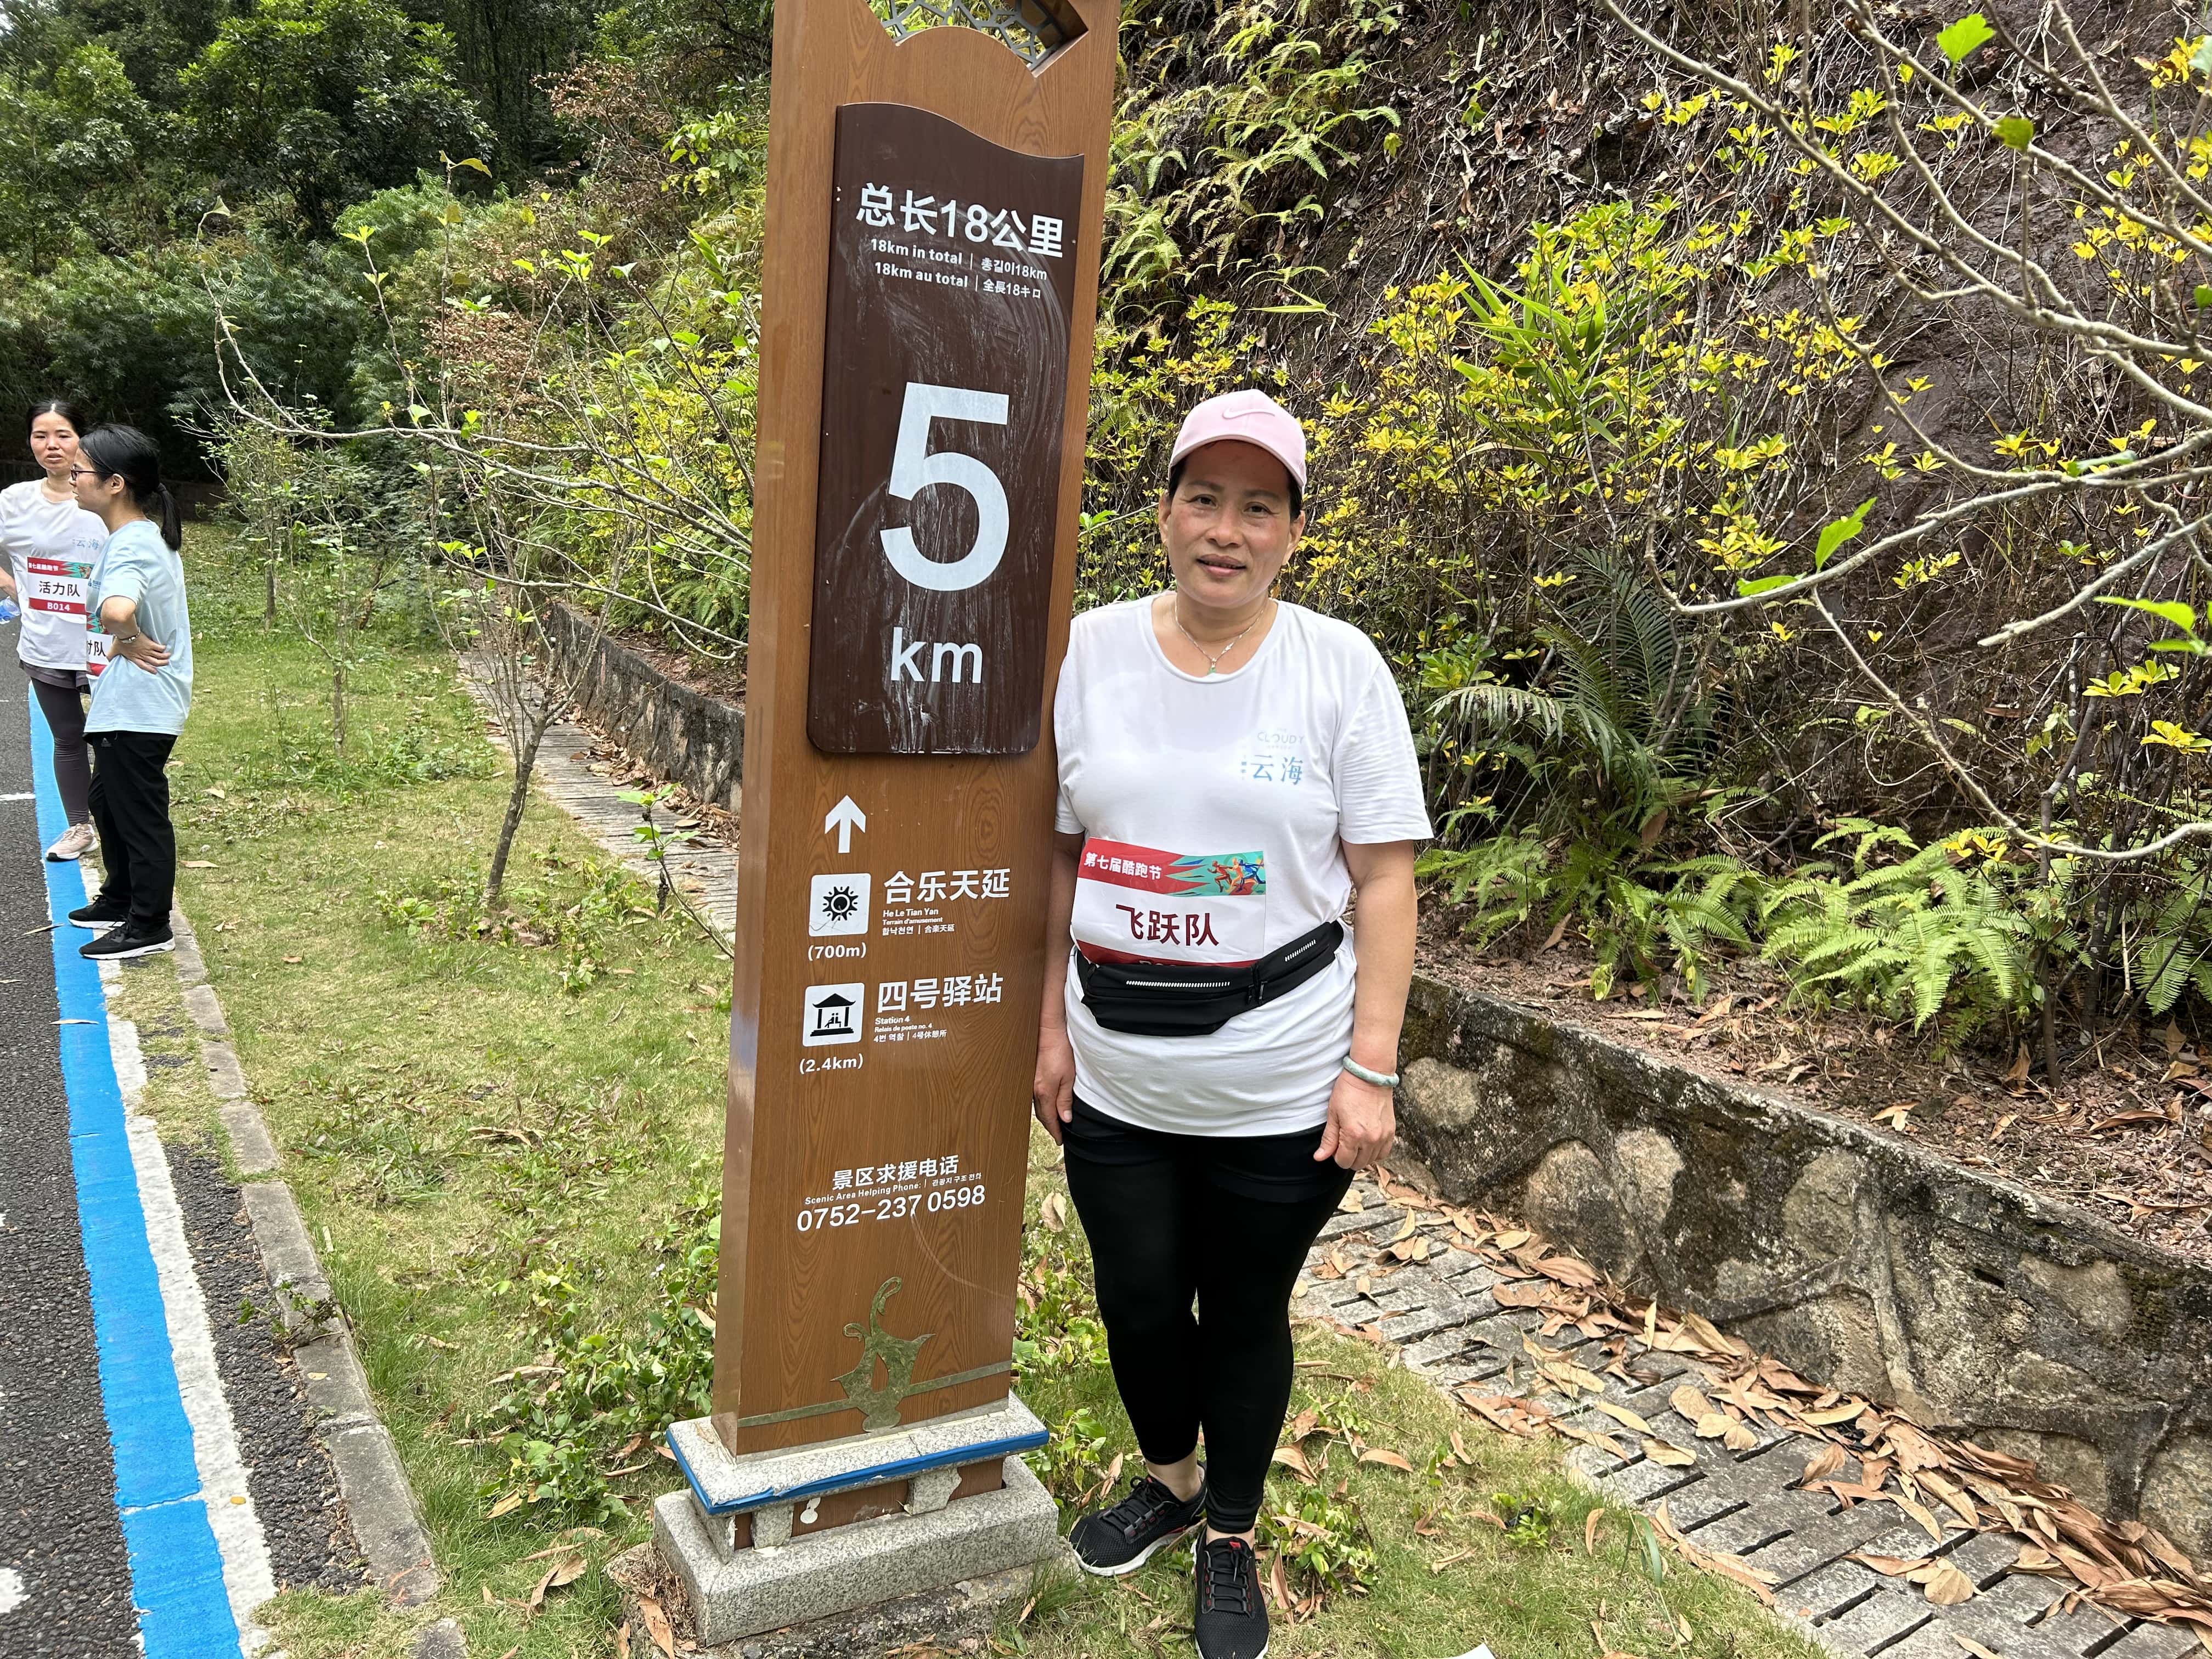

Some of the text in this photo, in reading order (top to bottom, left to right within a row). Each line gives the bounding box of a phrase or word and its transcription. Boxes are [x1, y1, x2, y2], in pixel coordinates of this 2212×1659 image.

[856, 182, 1063, 258] 总长18公里
[871, 238, 962, 266] 18km in total
[875, 262, 968, 288] 18km au total
[879, 381, 1009, 592] 5
[39, 580, 81, 597] 活力队
[47, 602, 70, 612] B014
[890, 627, 984, 684] km
[1250, 754, 1304, 785] 云海
[1084, 851, 1162, 880] 第七届酷跑节
[883, 868, 1011, 904] 合乐天延
[1115, 904, 1220, 947] 飞跃队
[808, 942, 867, 961] (700m)
[877, 973, 1003, 1013] 四号驿站
[874, 1017, 904, 1025] Station
[799, 1053, 864, 1075] (2.4km)
[832, 1154, 960, 1190] 景区求援电话
[797, 1184, 986, 1232] 0752-237 0598
[805, 1182, 922, 1205] Scenic Area Helping Phone:
